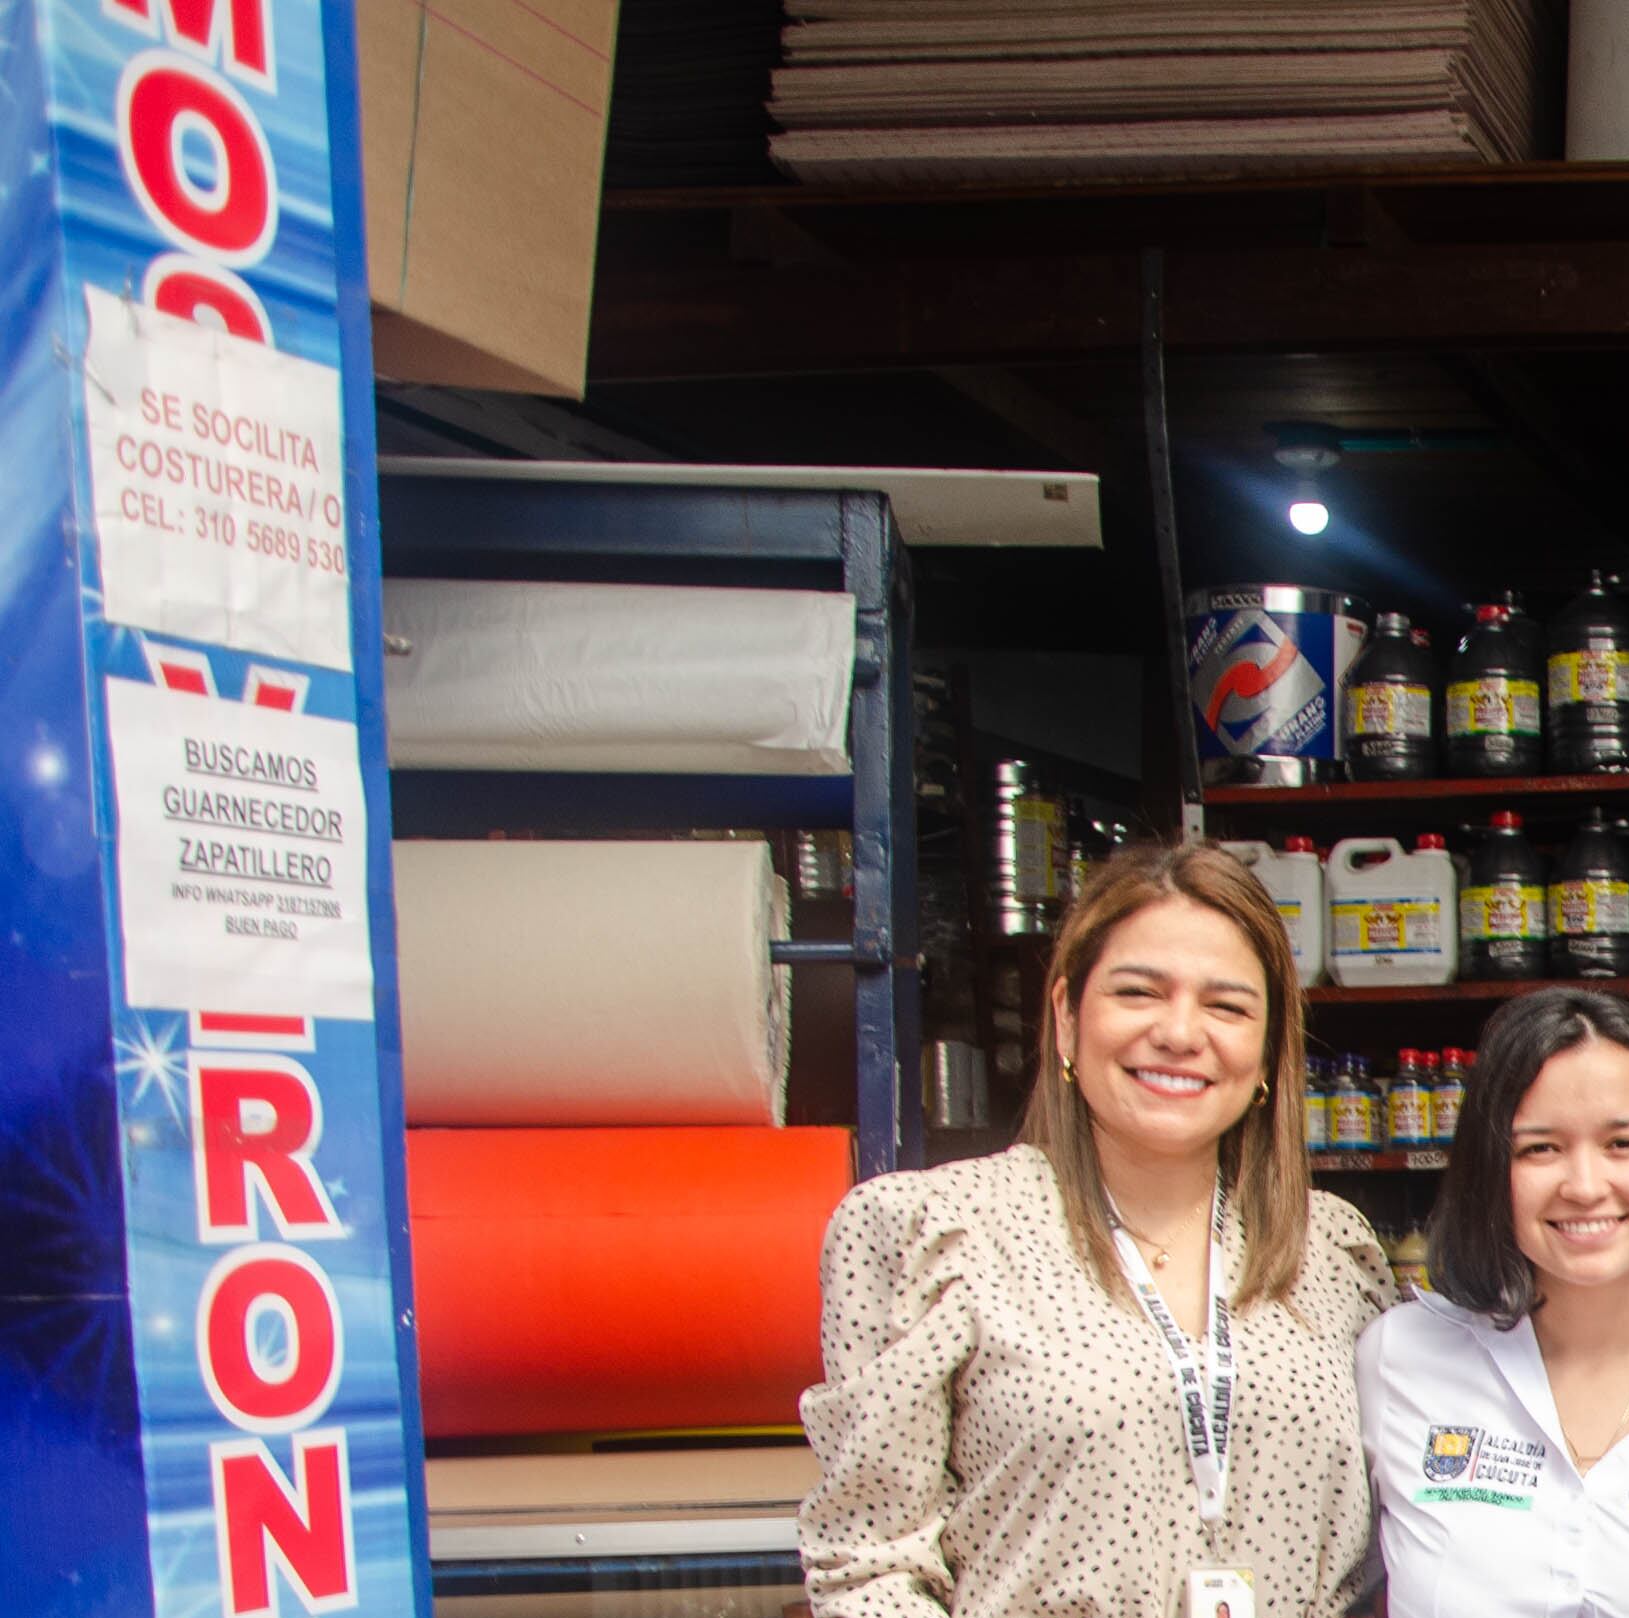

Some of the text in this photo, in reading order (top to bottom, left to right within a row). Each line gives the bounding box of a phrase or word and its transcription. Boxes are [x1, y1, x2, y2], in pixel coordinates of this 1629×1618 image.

[140, 386, 320, 474] SE SOCILITA
[120, 488, 345, 576] CEL: 310 5689 530
[184, 737, 319, 790] BUSCAMOS
[163, 785, 343, 841] GUARNECEDOR
[178, 837, 333, 887] ZAPATILLERO
[171, 882, 204, 901] INFO
[205, 886, 276, 909] WHATSAPP
